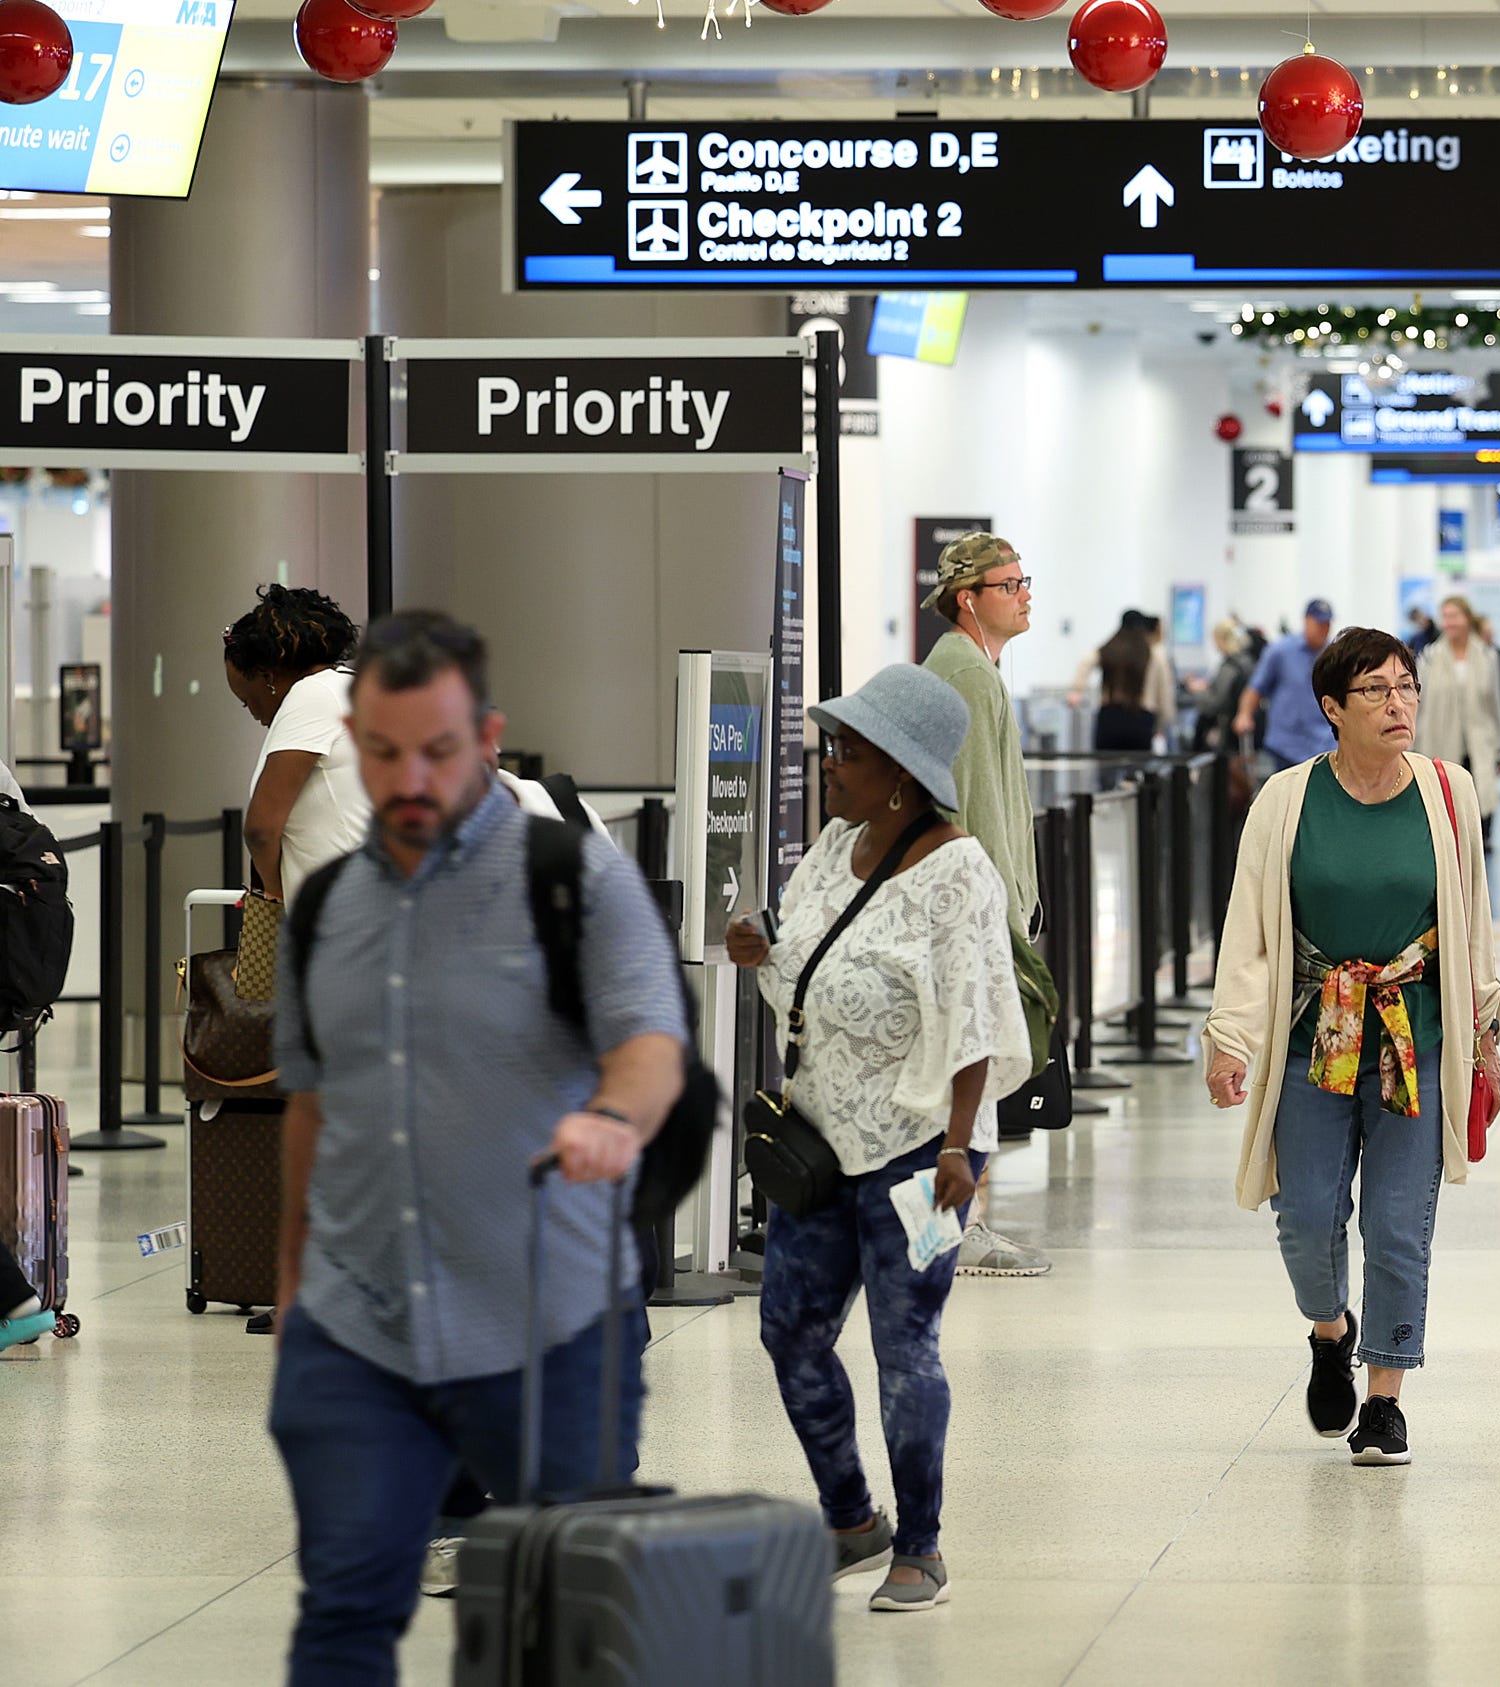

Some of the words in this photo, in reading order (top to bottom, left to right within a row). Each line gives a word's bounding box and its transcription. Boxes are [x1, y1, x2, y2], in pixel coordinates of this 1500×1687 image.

[58, 52, 114, 102] 17
[0, 123, 43, 149] nute
[47, 124, 91, 151] wait
[698, 132, 918, 168] Concourse
[930, 132, 998, 173] D,E
[1281, 128, 1460, 170] keting
[765, 171, 799, 193] D,E
[1272, 167, 1343, 189] Boletos
[698, 201, 928, 245] Checkpoint
[937, 202, 962, 237] 2
[699, 240, 768, 261] Control
[769, 240, 796, 261] de
[797, 240, 892, 264] Seguridad
[894, 240, 909, 260] 2
[19, 366, 267, 442] Priority
[477, 376, 732, 450] Priority
[1244, 464, 1280, 511] 2
[709, 724, 727, 751] TSA
[728, 724, 743, 752] Pre
[712, 775, 738, 798] Moved
[739, 776, 747, 798] to
